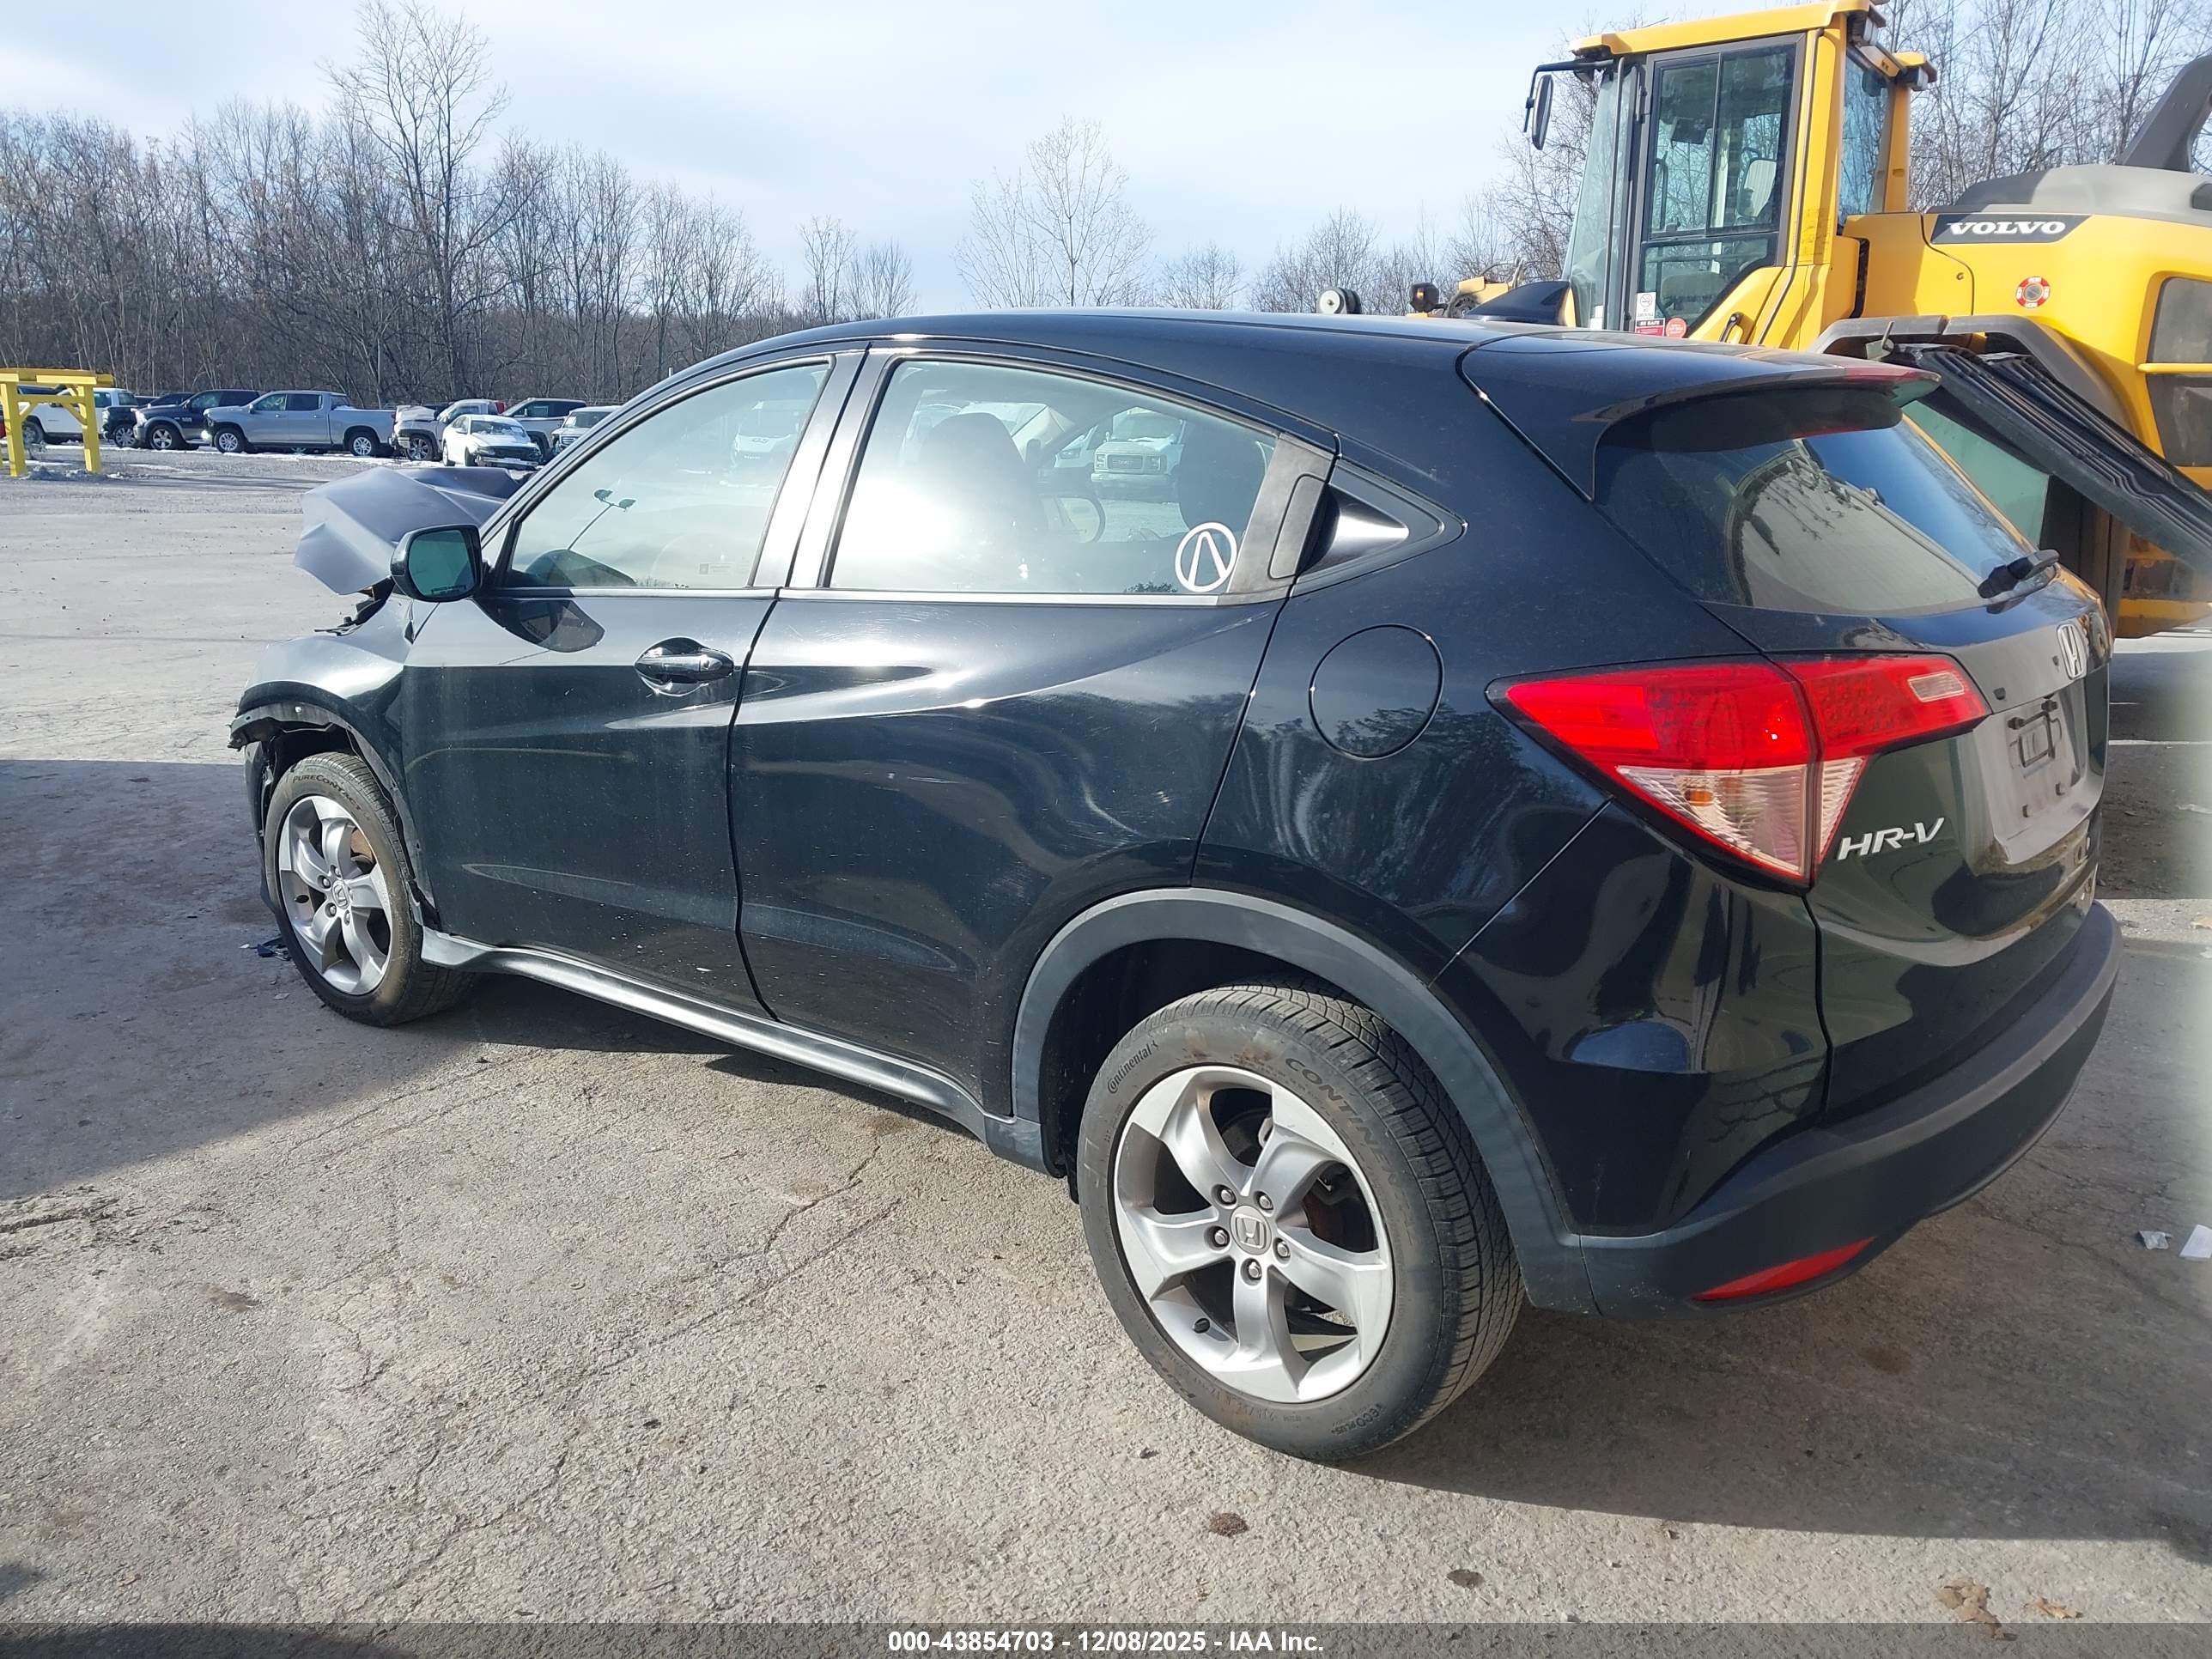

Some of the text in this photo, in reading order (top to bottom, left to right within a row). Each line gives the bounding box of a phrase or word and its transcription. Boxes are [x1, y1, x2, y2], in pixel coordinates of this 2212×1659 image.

[1946, 221, 2066, 235] VOLVO
[1837, 817, 1945, 861] HR-V
[1107, 1042, 1152, 1094] Continental
